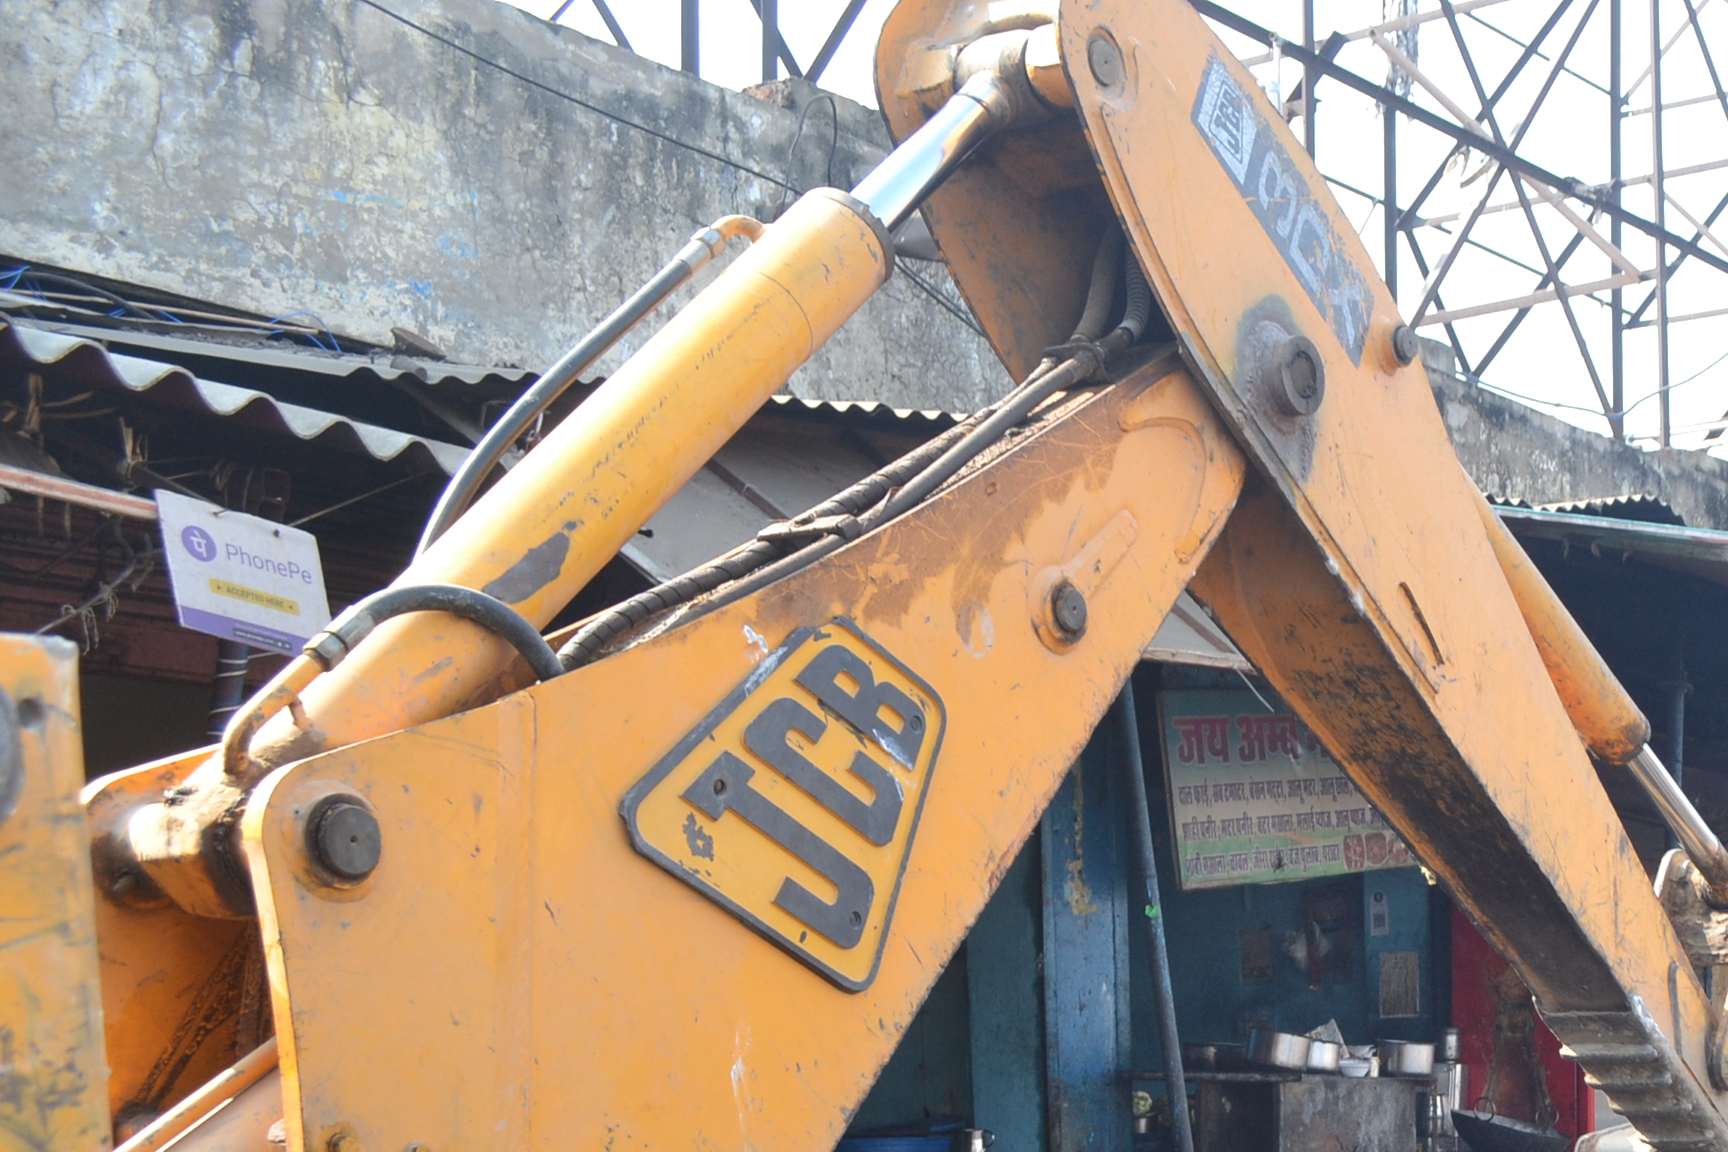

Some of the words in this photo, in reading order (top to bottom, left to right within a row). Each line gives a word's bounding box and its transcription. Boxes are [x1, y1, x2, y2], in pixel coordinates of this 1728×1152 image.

[225, 542, 313, 585] PhonePe
[226, 586, 265, 603] ACCEPTED
[265, 596, 285, 609] HERE
[1172, 715, 1231, 765] जय
[677, 644, 928, 949] JCB
